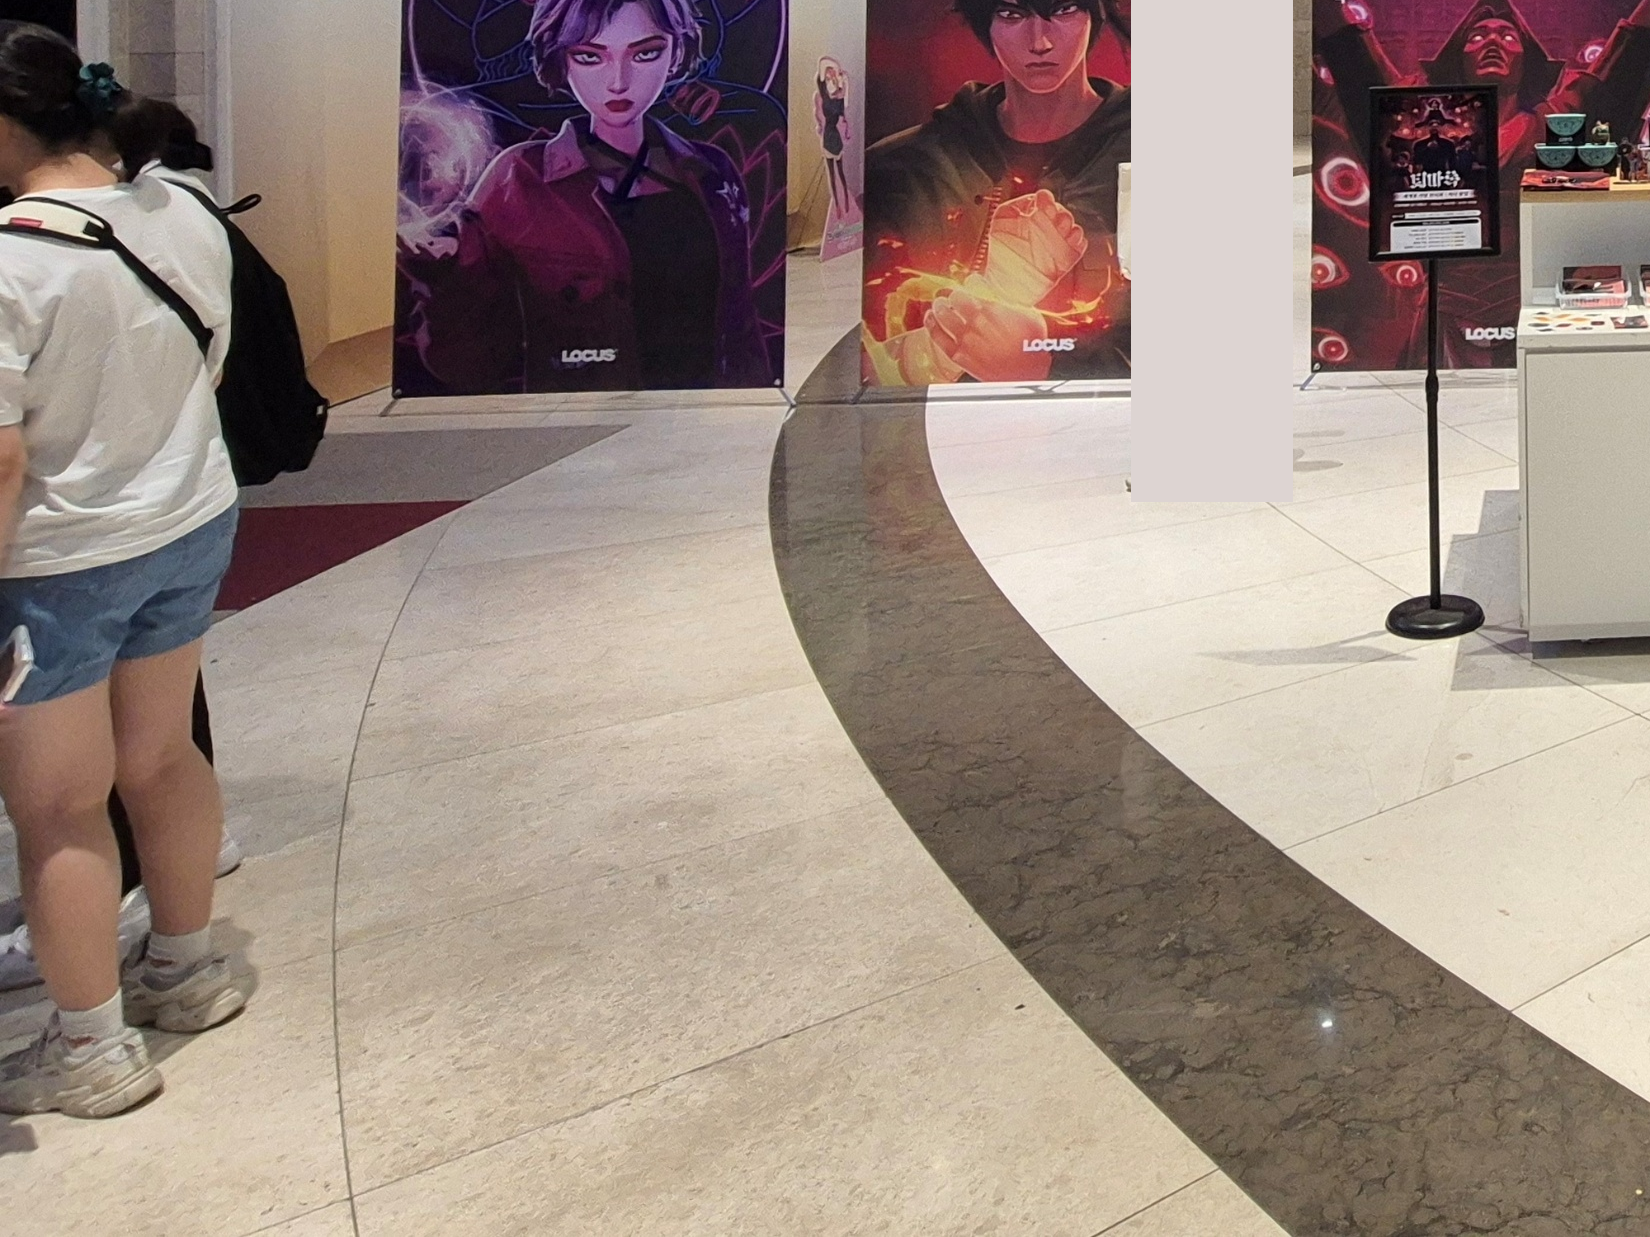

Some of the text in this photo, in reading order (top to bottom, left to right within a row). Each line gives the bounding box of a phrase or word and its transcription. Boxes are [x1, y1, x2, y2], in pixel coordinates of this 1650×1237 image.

[1409, 170, 1461, 189] 퇴마록
[1465, 326, 1516, 341] LOCUS
[1022, 337, 1076, 352] LOCUS
[561, 348, 617, 363] LOCUS
